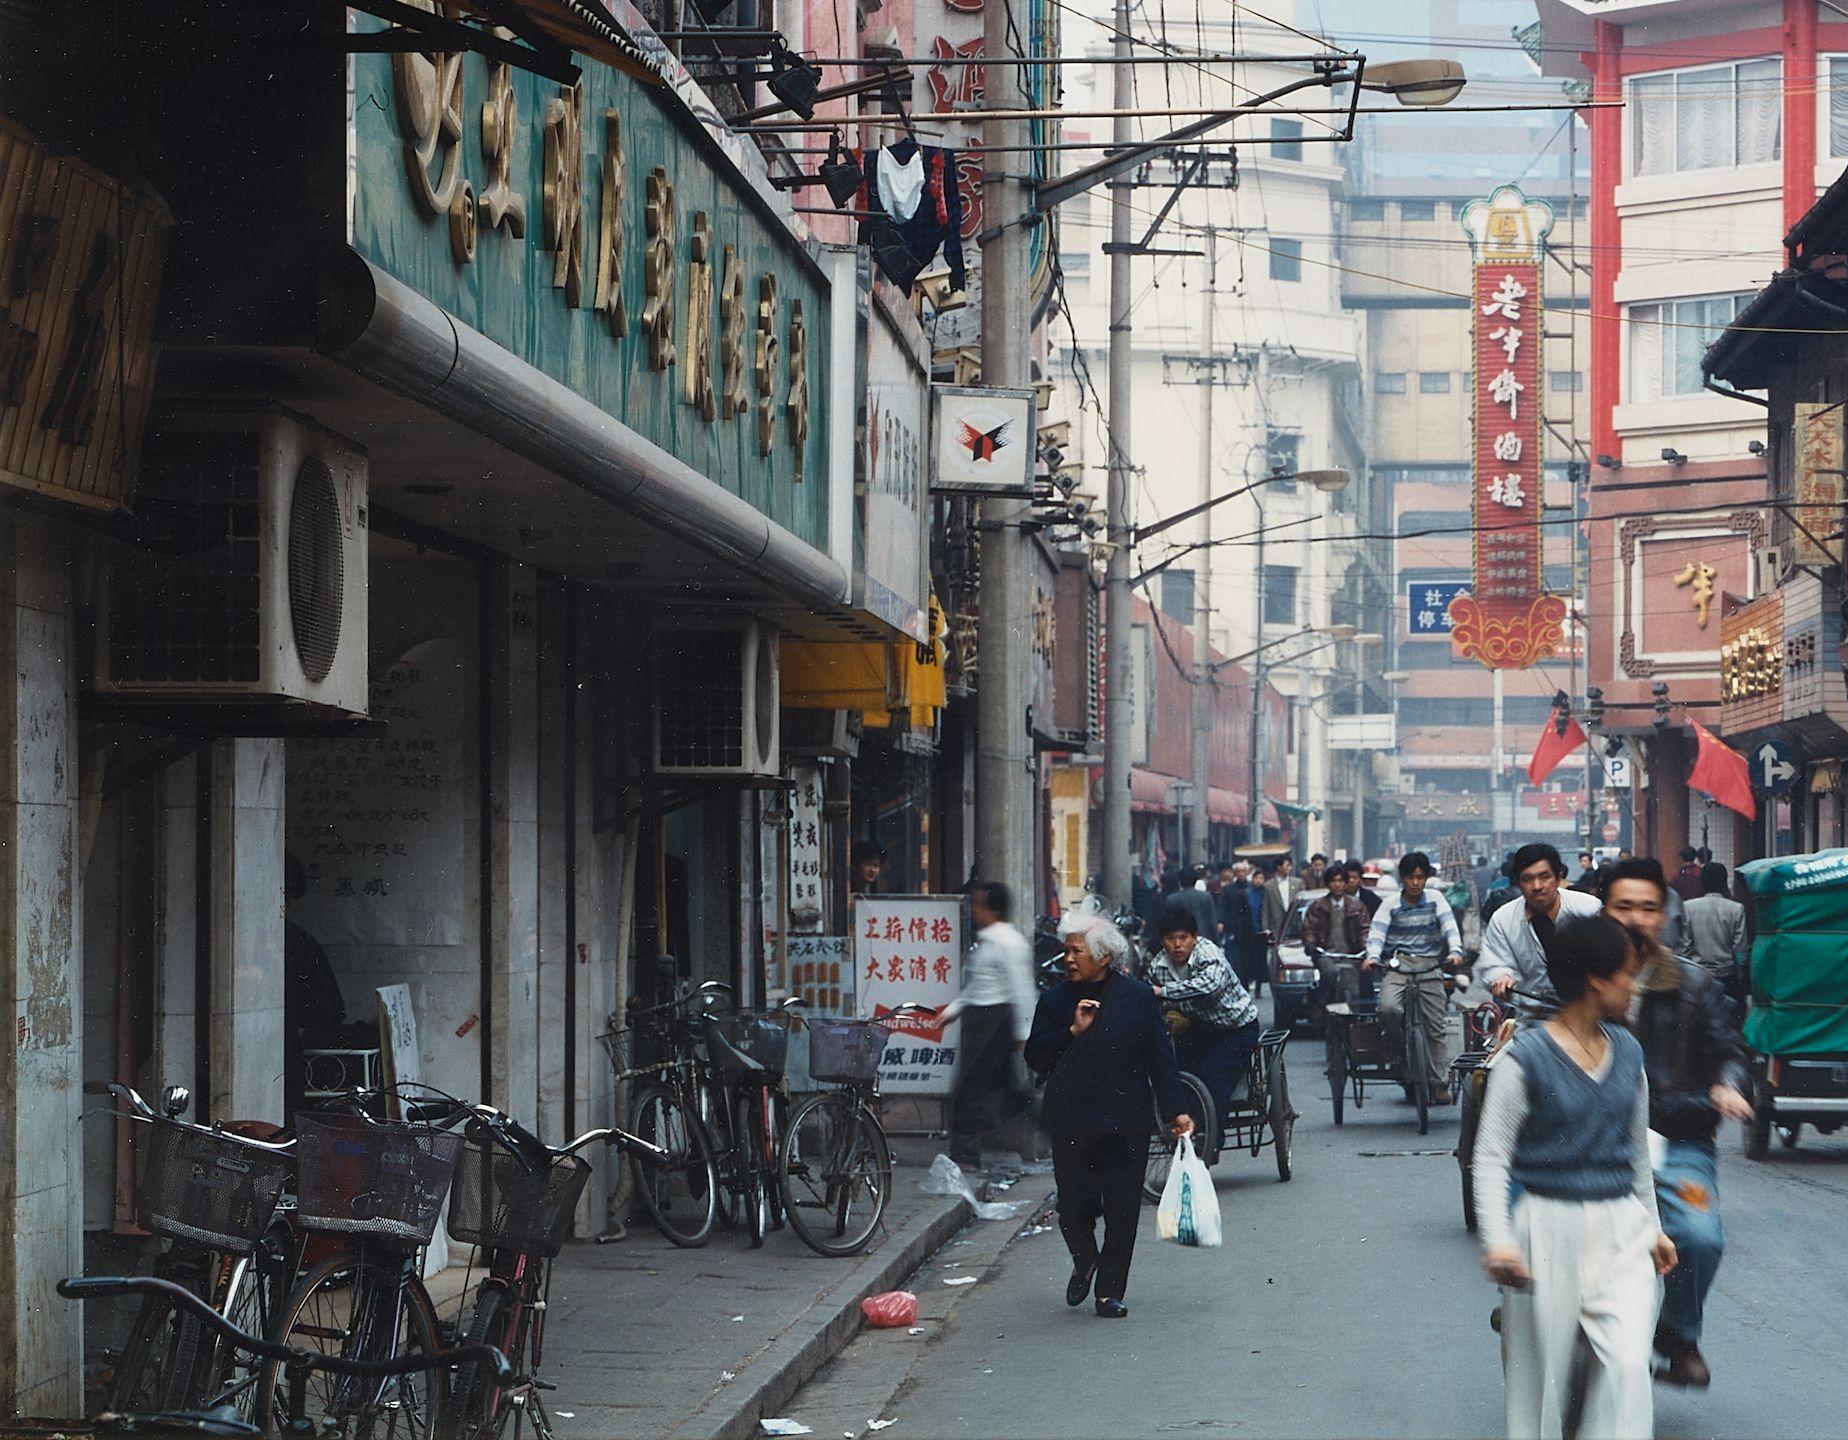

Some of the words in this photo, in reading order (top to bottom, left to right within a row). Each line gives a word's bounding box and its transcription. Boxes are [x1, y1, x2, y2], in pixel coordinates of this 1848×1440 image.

[1610, 760, 1623, 776] P
[879, 1047, 958, 1067] 威啤酒
